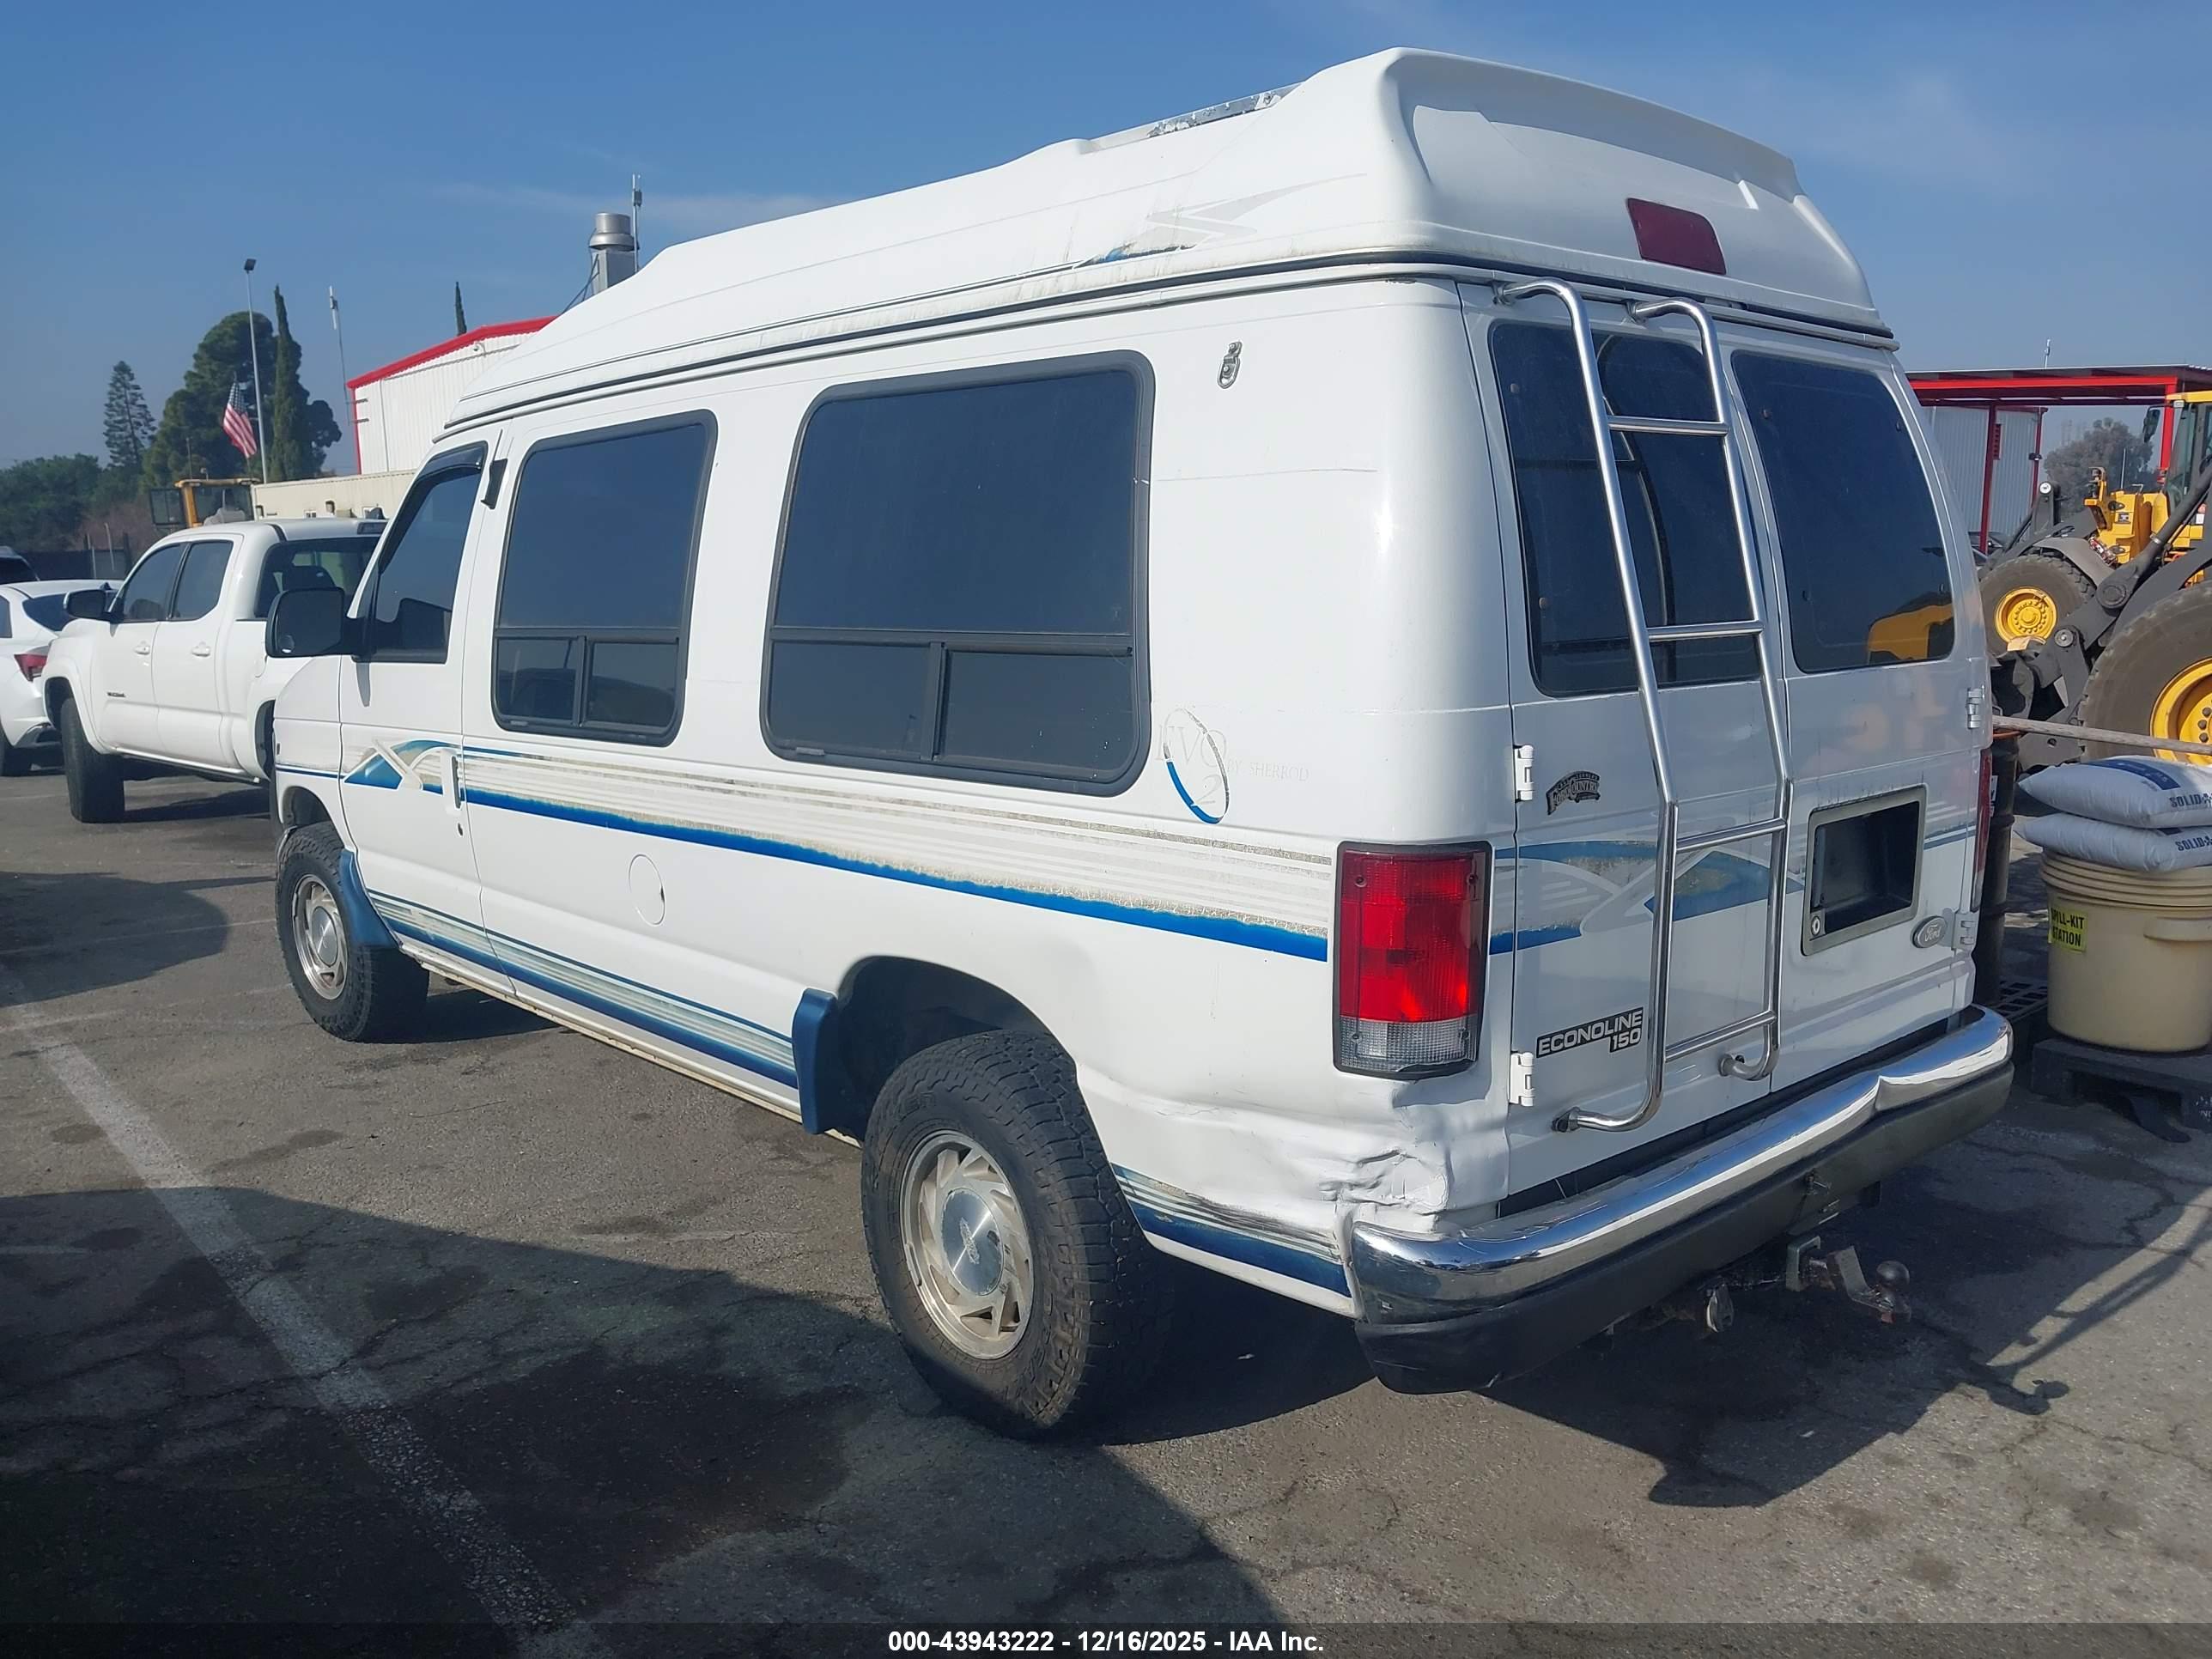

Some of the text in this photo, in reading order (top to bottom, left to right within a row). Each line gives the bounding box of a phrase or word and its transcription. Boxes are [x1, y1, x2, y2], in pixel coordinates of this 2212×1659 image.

[1249, 761, 1310, 782] SHERROD
[2052, 926, 2081, 946] STATION
[1538, 1010, 1643, 1055] ECONOLINE
[1613, 1027, 1642, 1050] 150
